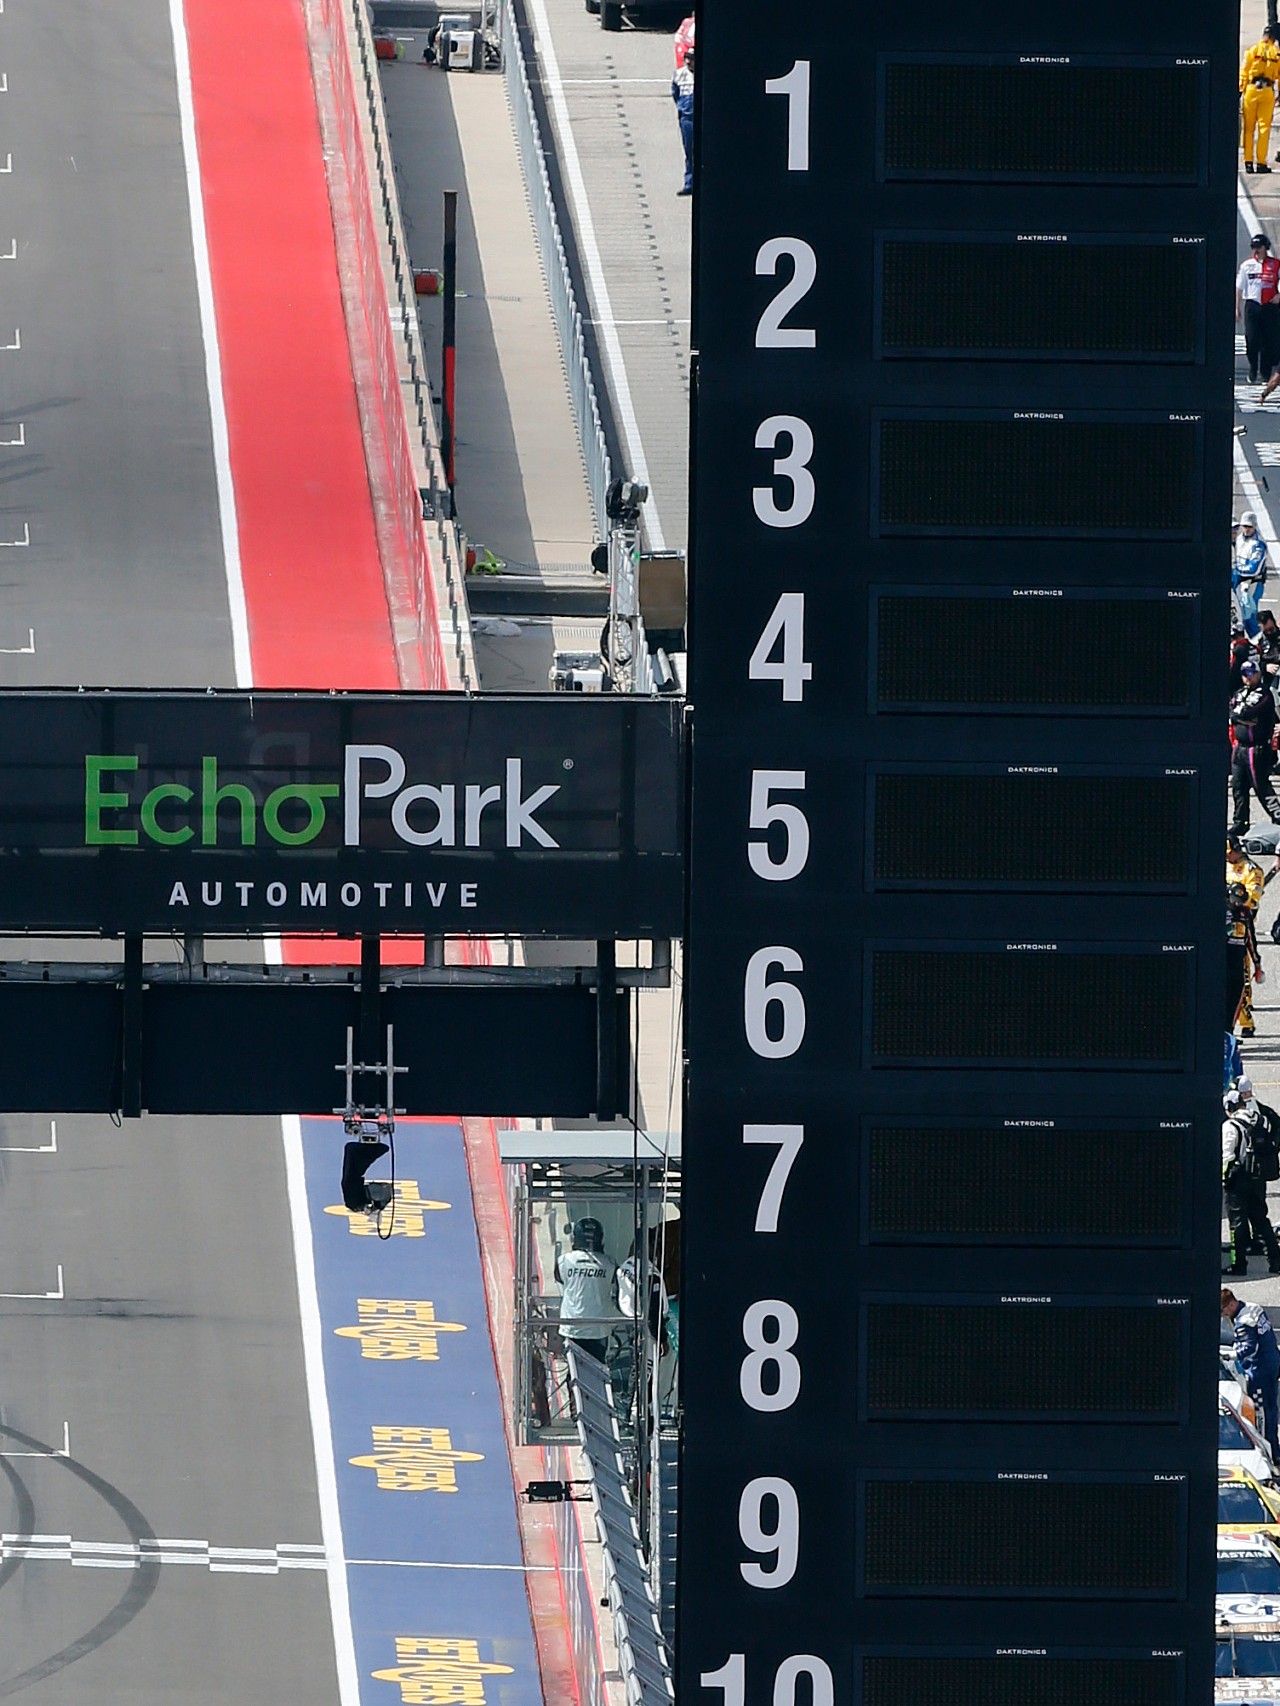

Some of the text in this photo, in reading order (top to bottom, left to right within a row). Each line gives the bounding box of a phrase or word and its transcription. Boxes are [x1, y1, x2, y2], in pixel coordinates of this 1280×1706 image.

[766, 61, 809, 170] 1
[756, 237, 816, 347] 2
[1016, 234, 1068, 242] DAKTRONICS
[1013, 412, 1064, 420] DAKTRONICS
[753, 416, 815, 527] 3
[749, 593, 812, 701] 4
[84, 744, 561, 848] EchoPark
[748, 770, 809, 880] 5
[169, 881, 479, 907] AUTOMOTIVE
[745, 946, 805, 1058] 6
[743, 1125, 803, 1232] 7
[567, 1267, 607, 1278] OFFICIAL
[740, 1300, 800, 1411] 8
[739, 1477, 799, 1588] 9
